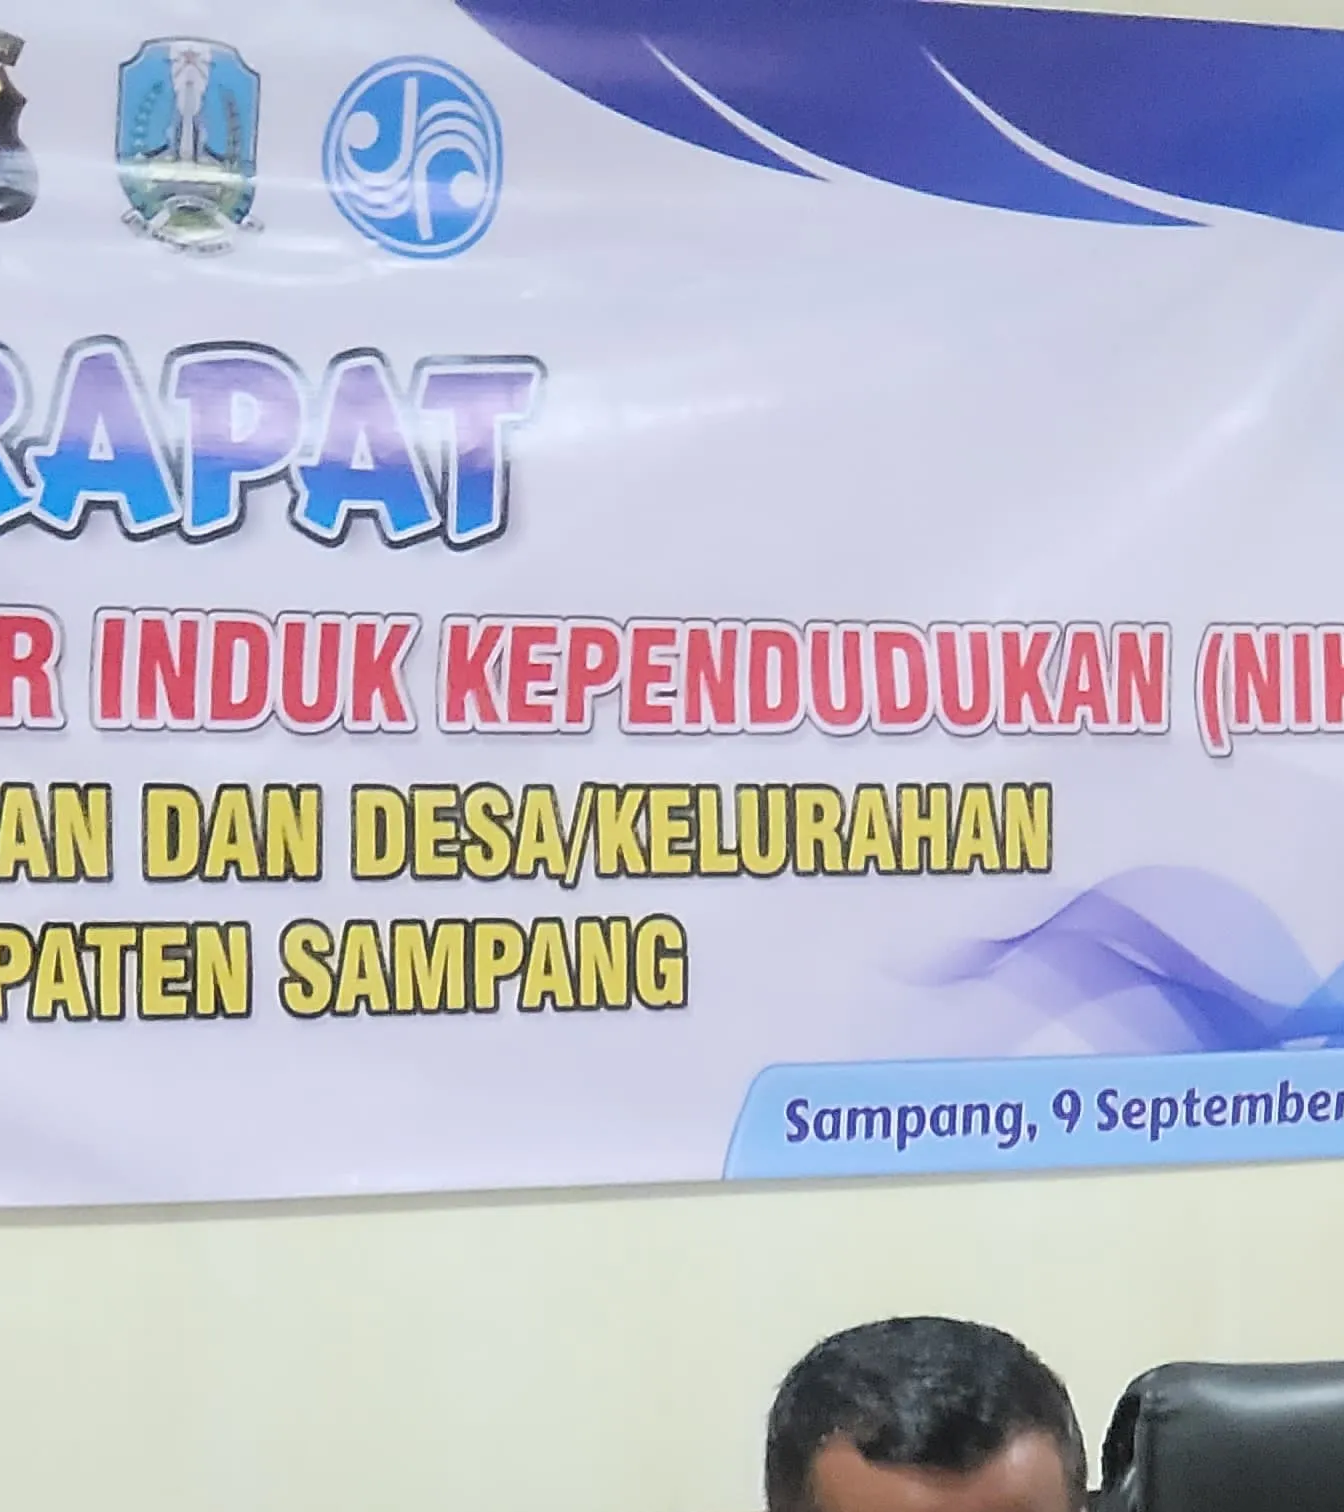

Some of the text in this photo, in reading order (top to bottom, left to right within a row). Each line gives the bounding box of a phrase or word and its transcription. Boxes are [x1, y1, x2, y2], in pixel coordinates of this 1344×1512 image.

[90, 606, 420, 733] INDUK
[436, 614, 1172, 736] KEPENDUDUKAN
[141, 783, 323, 881] DAN
[350, 781, 1053, 888] DESA/KELURAHAN
[279, 914, 688, 1020] SAMPANG
[784, 1094, 1039, 1150] Sampang,
[1053, 1089, 1083, 1134] 9
